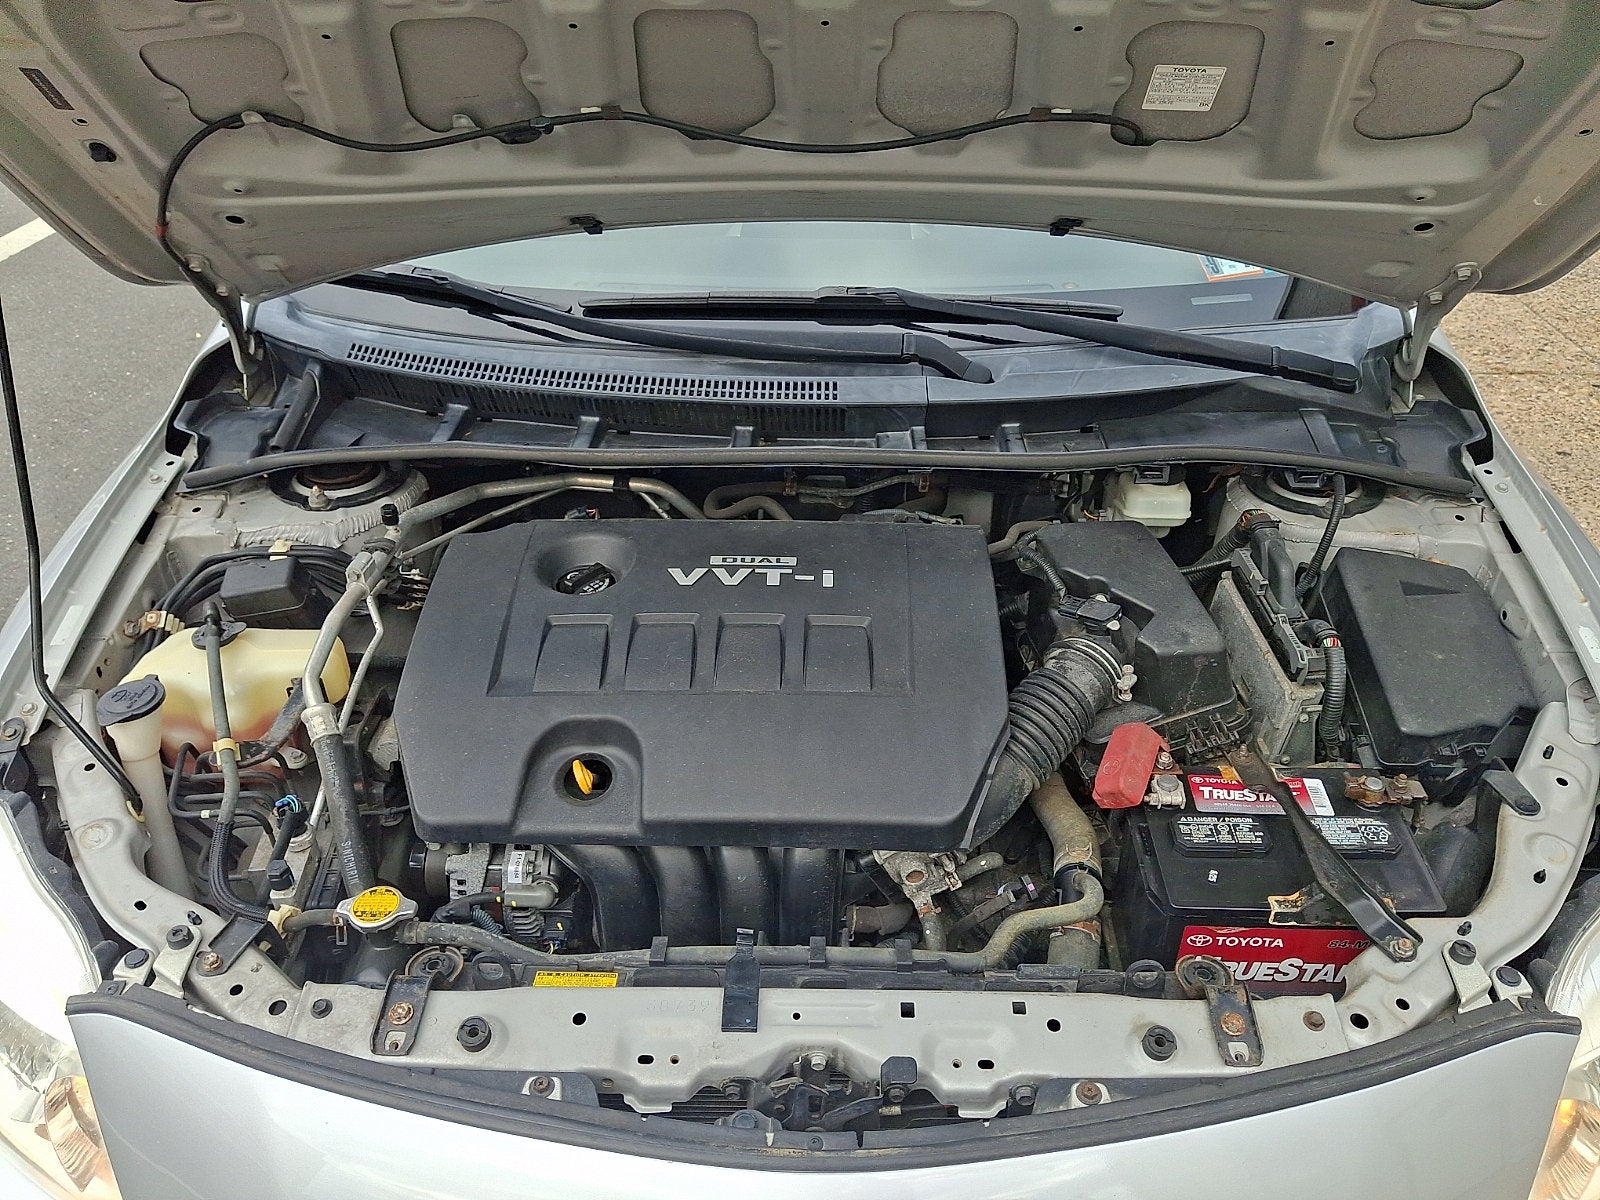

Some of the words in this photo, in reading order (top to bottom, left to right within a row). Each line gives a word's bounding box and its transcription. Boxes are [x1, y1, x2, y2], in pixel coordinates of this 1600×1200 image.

[721, 556, 790, 564] DUAL
[667, 567, 834, 588] VVT-i
[1204, 777, 1239, 785] TOYOTA
[1216, 936, 1284, 948] TOYOTA
